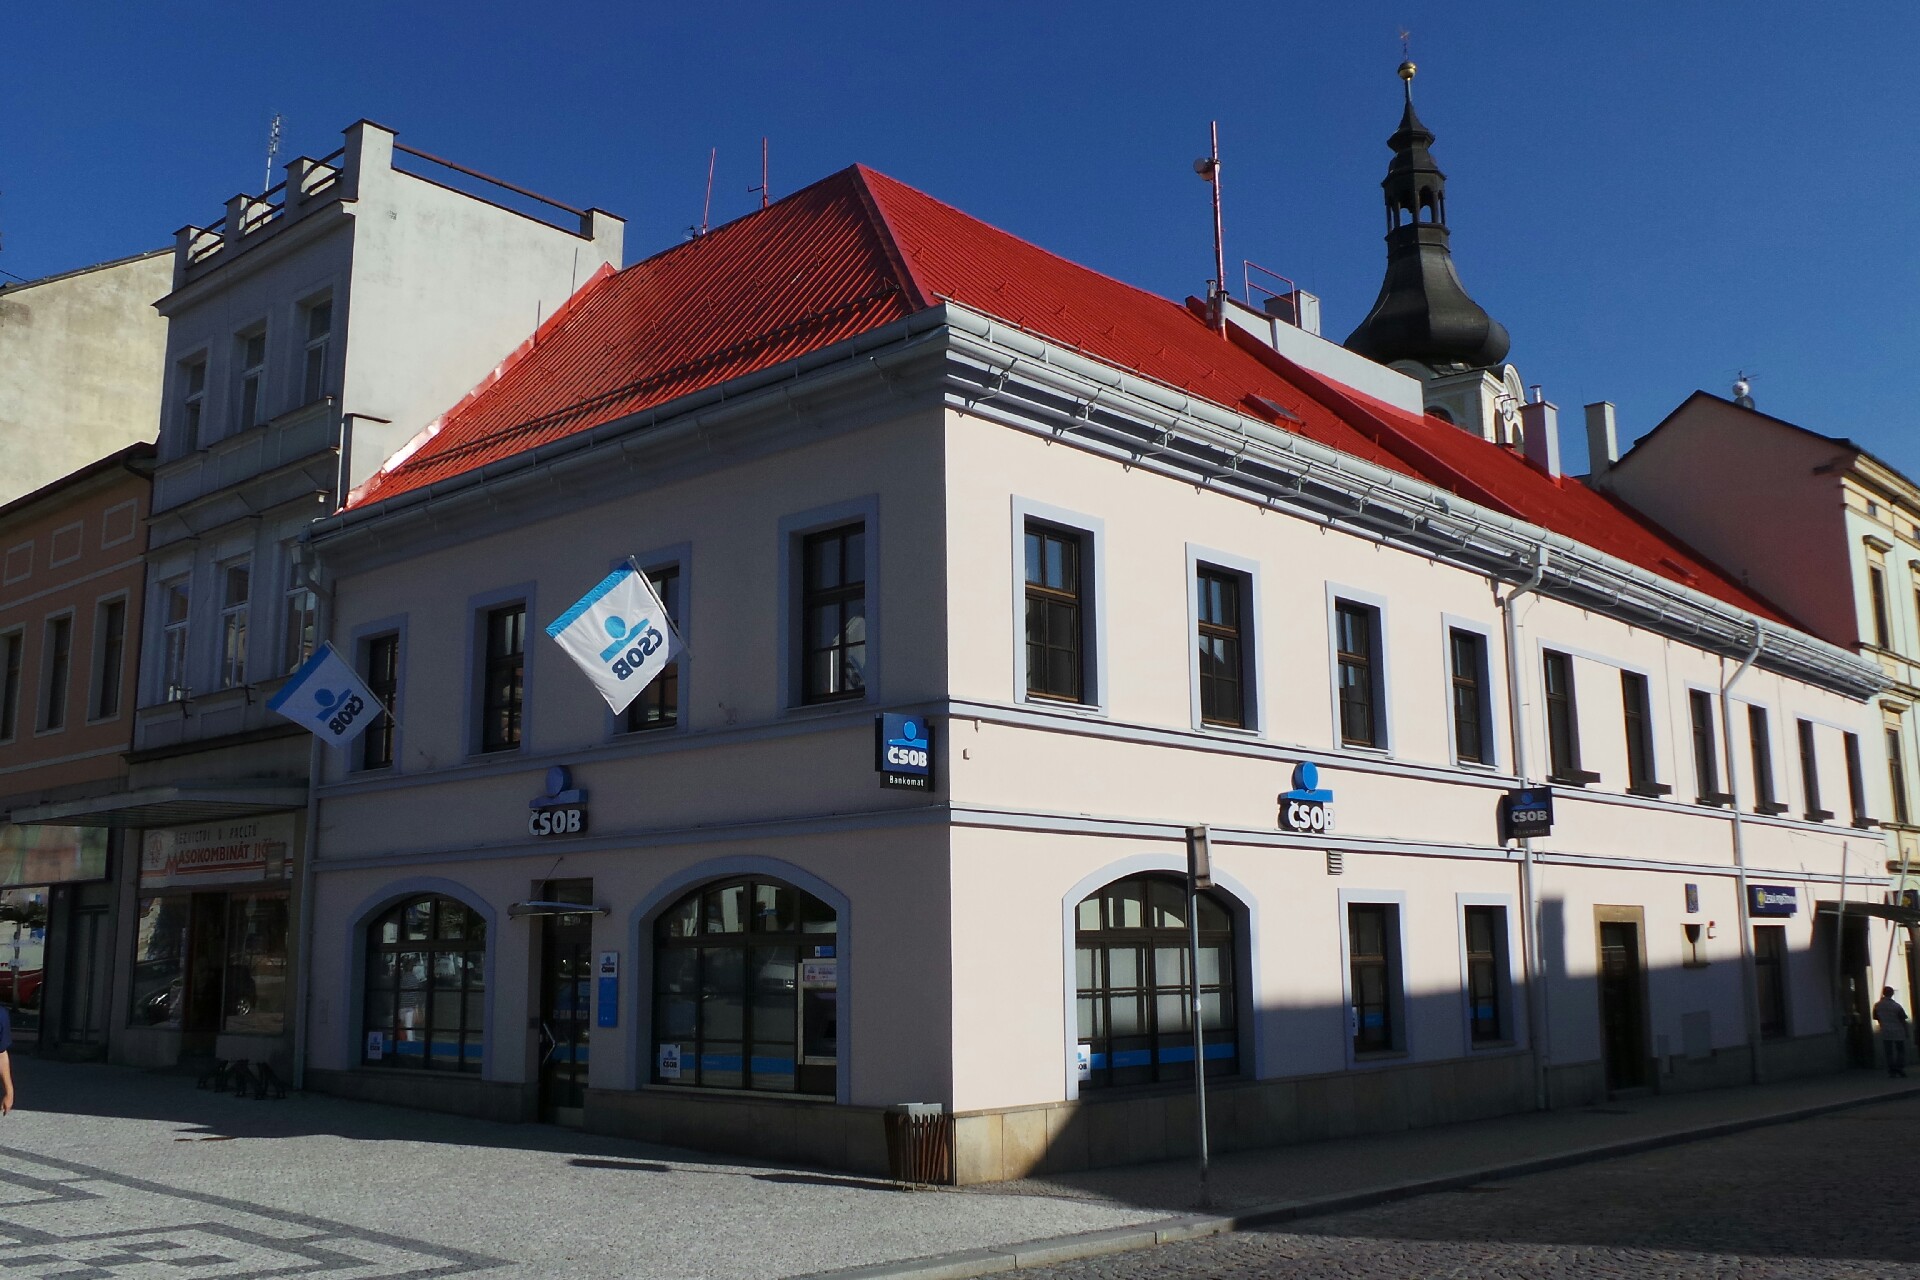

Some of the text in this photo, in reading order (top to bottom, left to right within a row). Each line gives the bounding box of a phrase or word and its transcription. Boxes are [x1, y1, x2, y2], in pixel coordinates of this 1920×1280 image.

[888, 746, 928, 767] ČSOB
[889, 775, 925, 787] Bankomat
[528, 810, 581, 836] ČSOB
[1288, 801, 1336, 831] ČSOB
[1511, 810, 1548, 823] ČSOB
